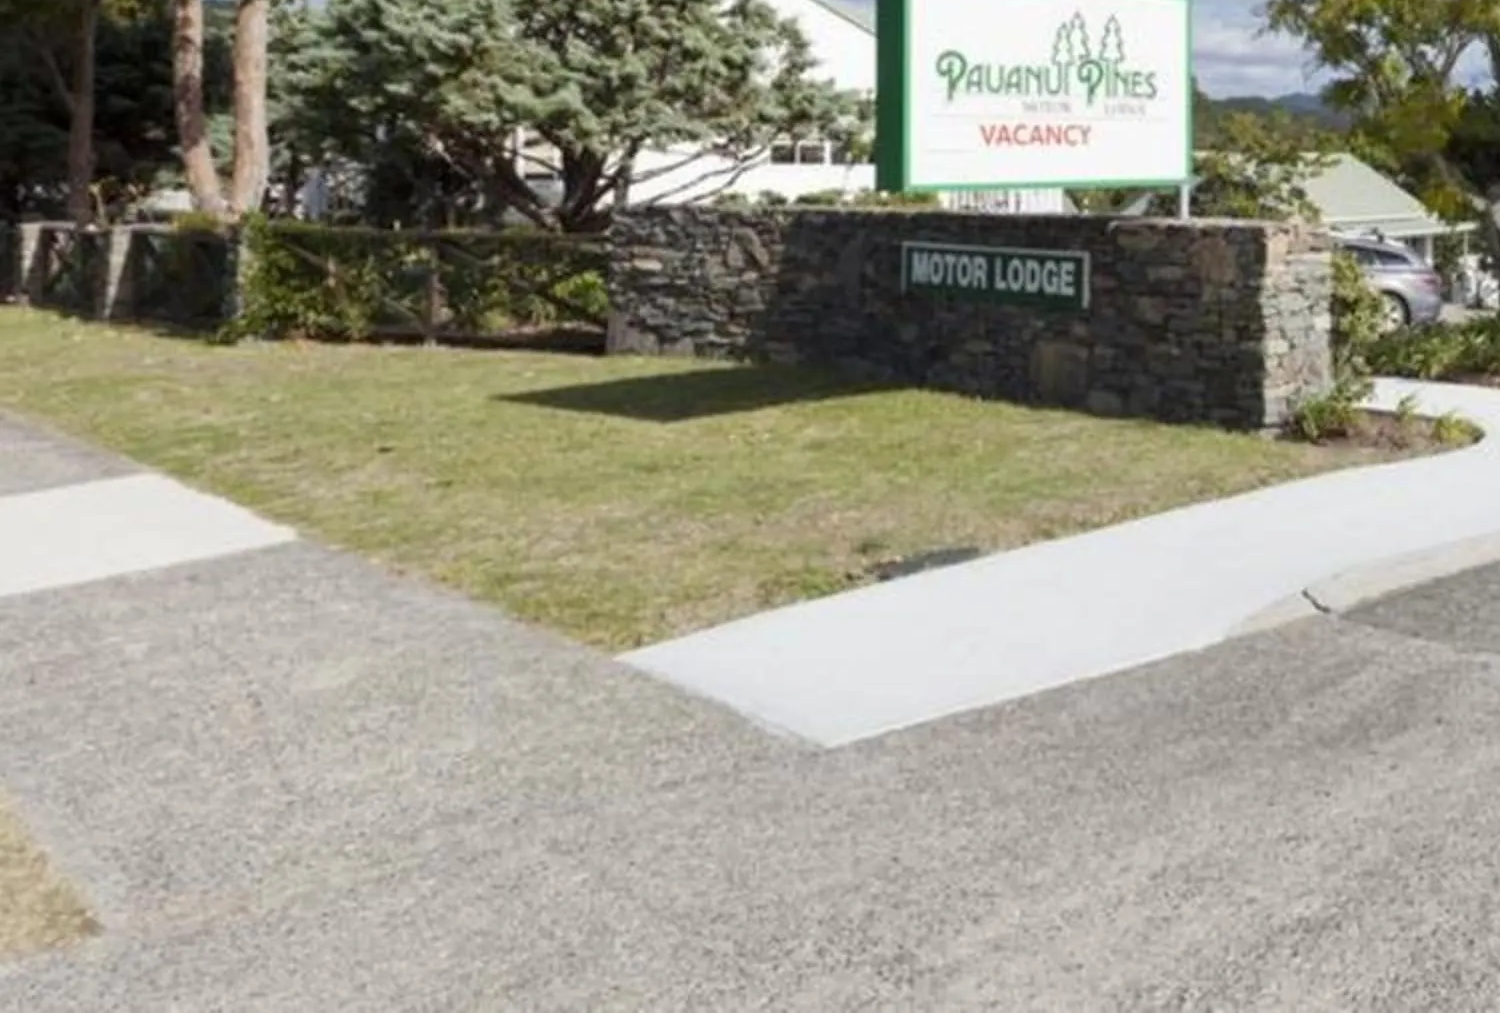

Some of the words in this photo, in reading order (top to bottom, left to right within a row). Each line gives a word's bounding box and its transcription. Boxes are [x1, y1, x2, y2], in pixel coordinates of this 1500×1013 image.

[979, 123, 1092, 147] VACANCY
[911, 250, 988, 289] MOTOR
[994, 256, 1076, 296] LODGE
